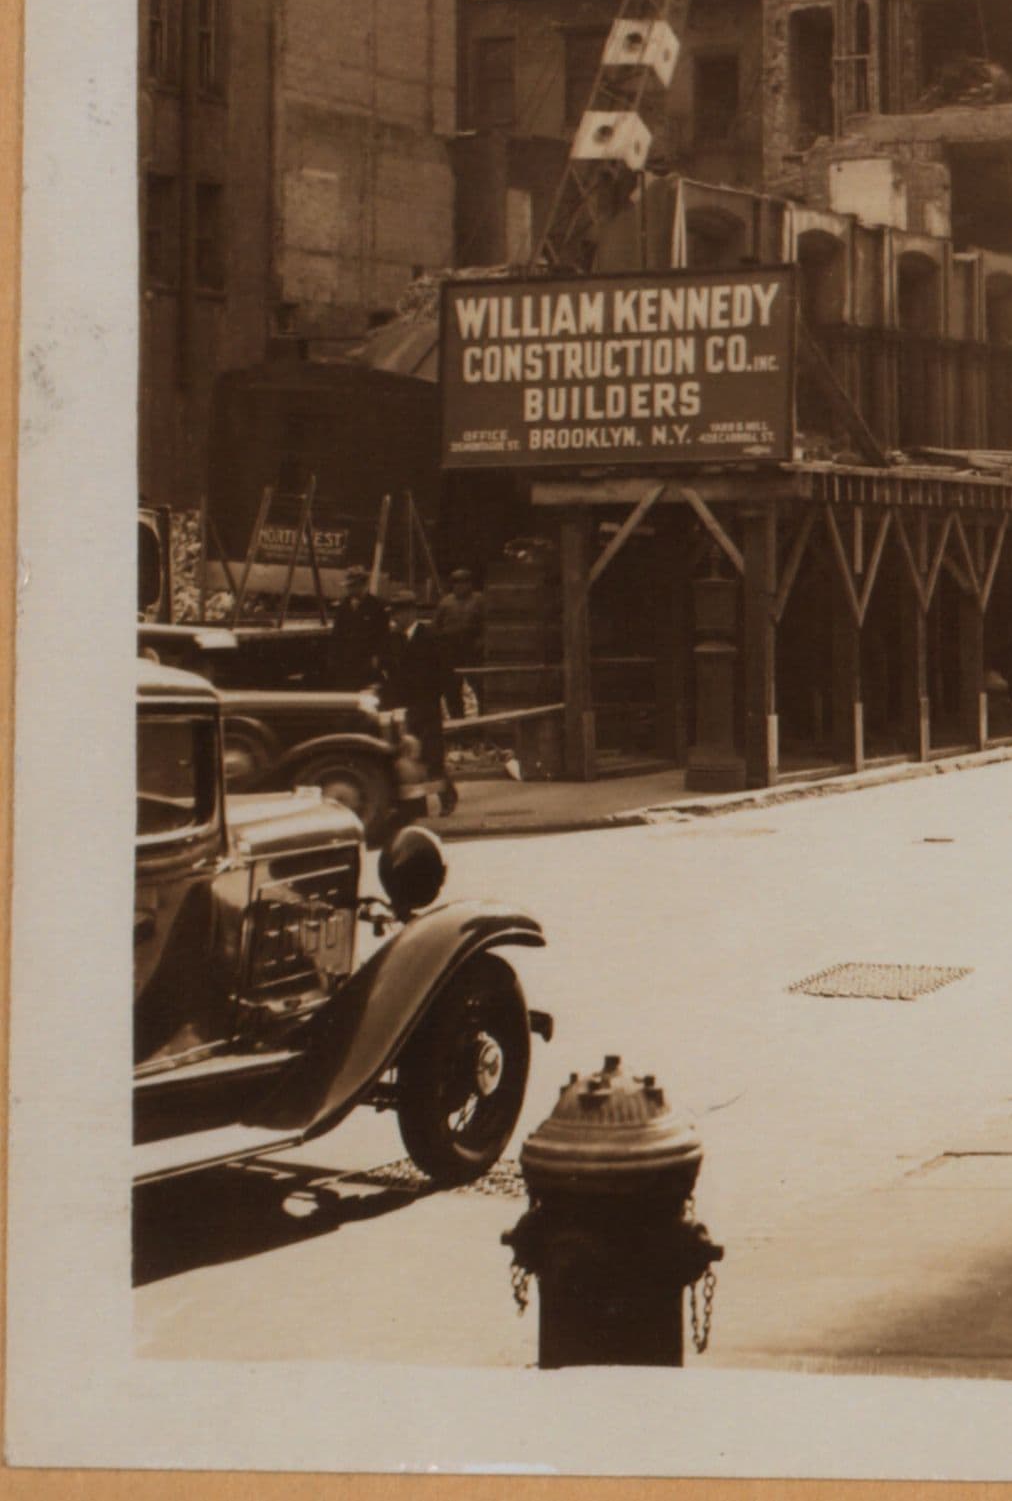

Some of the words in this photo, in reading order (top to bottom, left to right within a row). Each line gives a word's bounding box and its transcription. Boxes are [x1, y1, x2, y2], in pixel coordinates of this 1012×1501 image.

[455, 293, 603, 339] WILLIAM
[614, 284, 778, 332] KENNEDY
[463, 337, 695, 382] CONSTRUCTION
[705, 334, 752, 373] CO.
[525, 384, 700, 421] BUILDERS
[463, 429, 508, 442] OFFICE
[652, 423, 691, 446] N.Y.
